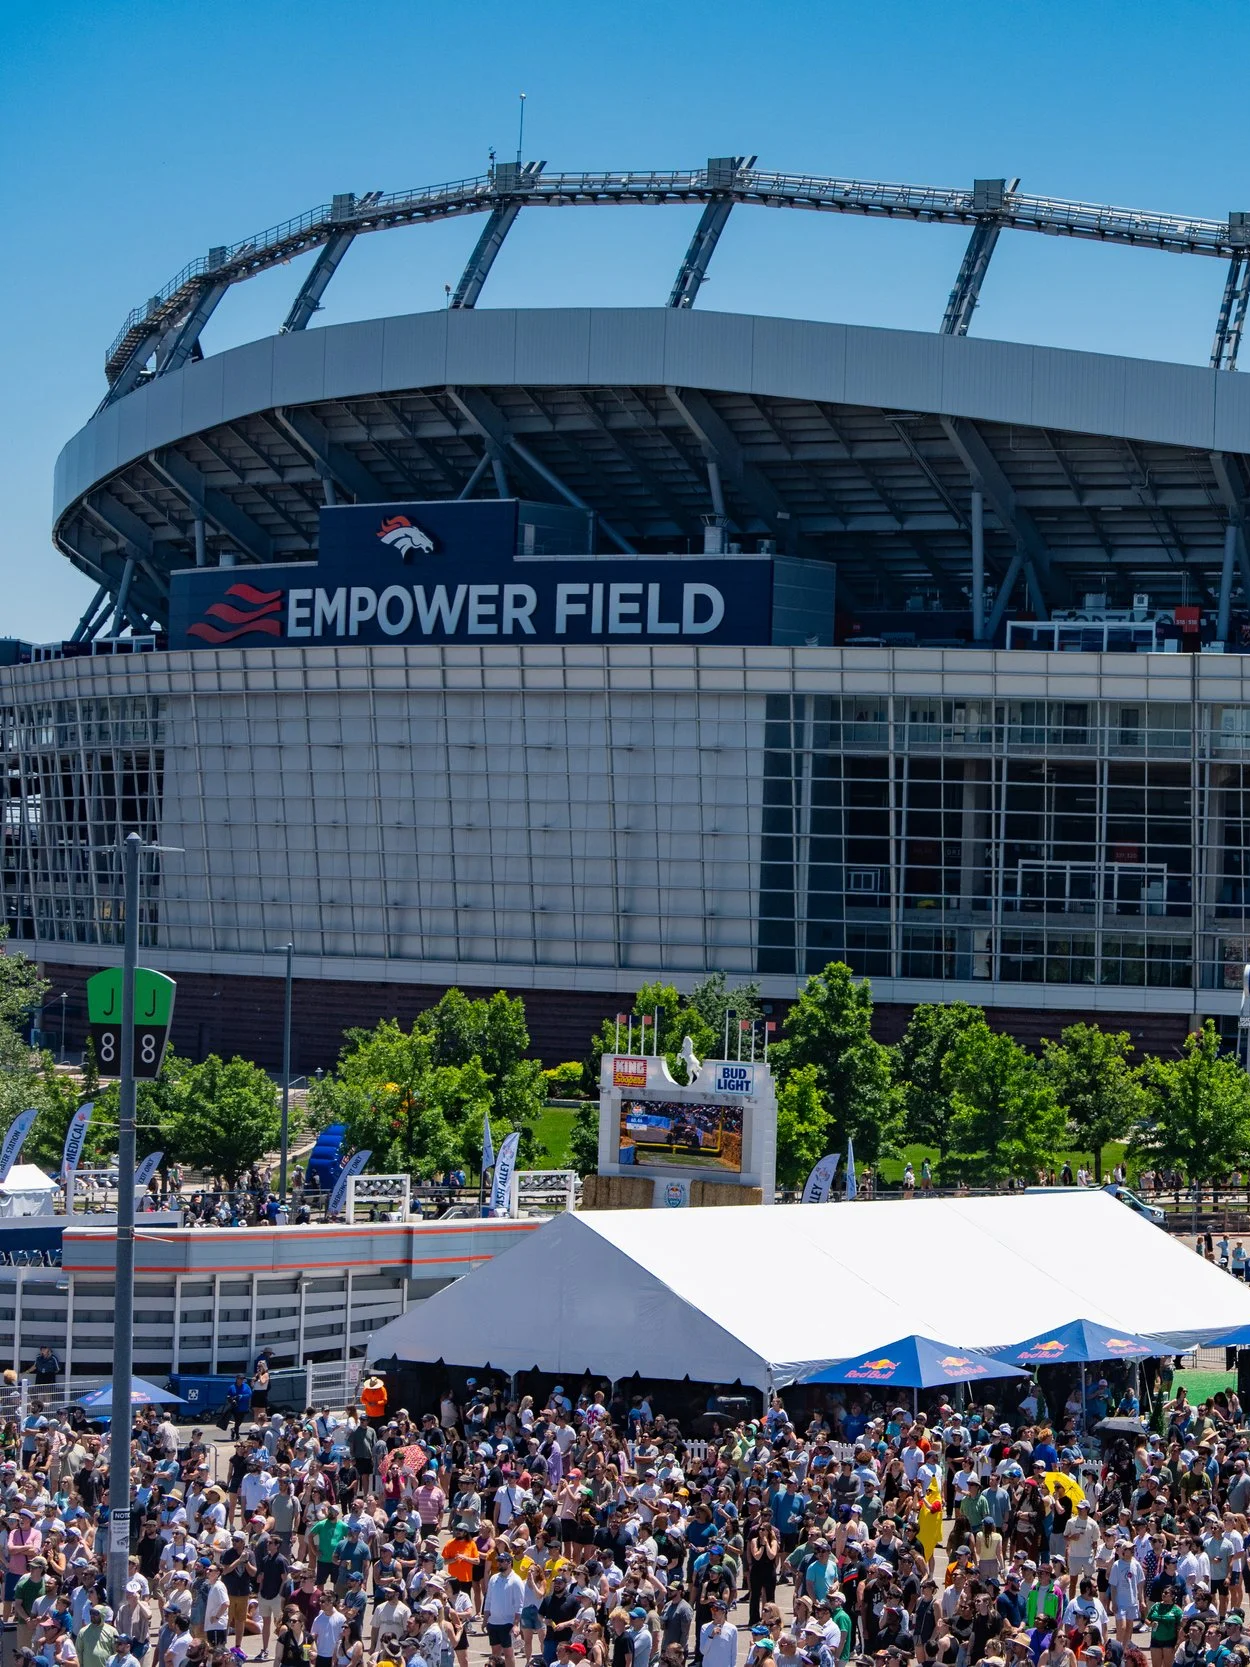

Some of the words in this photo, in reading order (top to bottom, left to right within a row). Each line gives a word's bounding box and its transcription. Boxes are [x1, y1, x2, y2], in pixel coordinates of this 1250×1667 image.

[287, 584, 537, 638] EMPOWER
[555, 583, 725, 635] FIELD
[103, 988, 114, 1016] J
[145, 989, 156, 1017] J
[101, 1032, 115, 1062] 8
[141, 1034, 156, 1064] 8
[615, 1059, 644, 1074] KING
[722, 1067, 747, 1080] BUD
[717, 1078, 751, 1092] LIGHT
[6, 1130, 21, 1155] STATION
[66, 1123, 85, 1163] MEDICAL
[144, 1158, 154, 1174] ONLY
[499, 1161, 510, 1187] ALLEY
[496, 1188, 506, 1207] ASH
[1017, 1350, 1039, 1359] Red
[1039, 1349, 1064, 1359] Bull
[844, 1369, 867, 1379] Red
[867, 1369, 895, 1379] Bull
